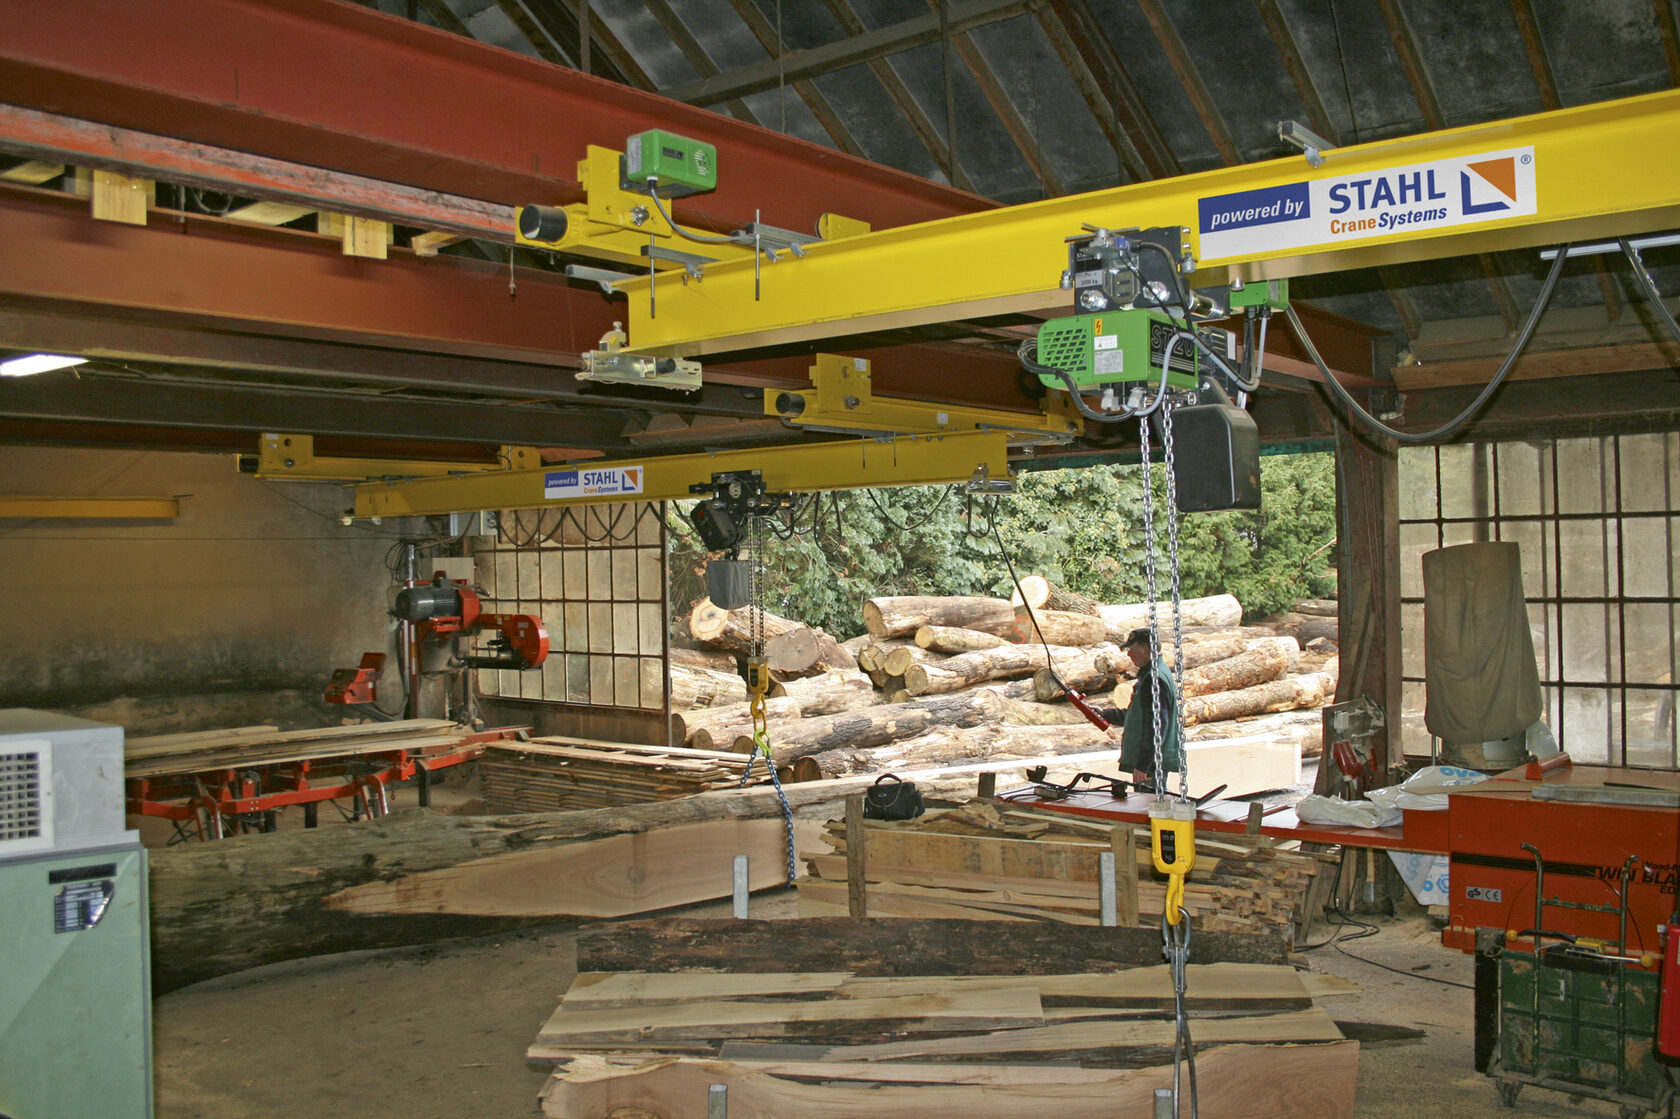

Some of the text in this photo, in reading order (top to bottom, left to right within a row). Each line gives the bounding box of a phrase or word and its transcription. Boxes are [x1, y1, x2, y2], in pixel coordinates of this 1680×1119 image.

[1329, 169, 1447, 215] STAHL
[1210, 199, 1304, 230] powered by
[548, 477, 577, 487] powered by
[583, 471, 618, 486] STAHL
